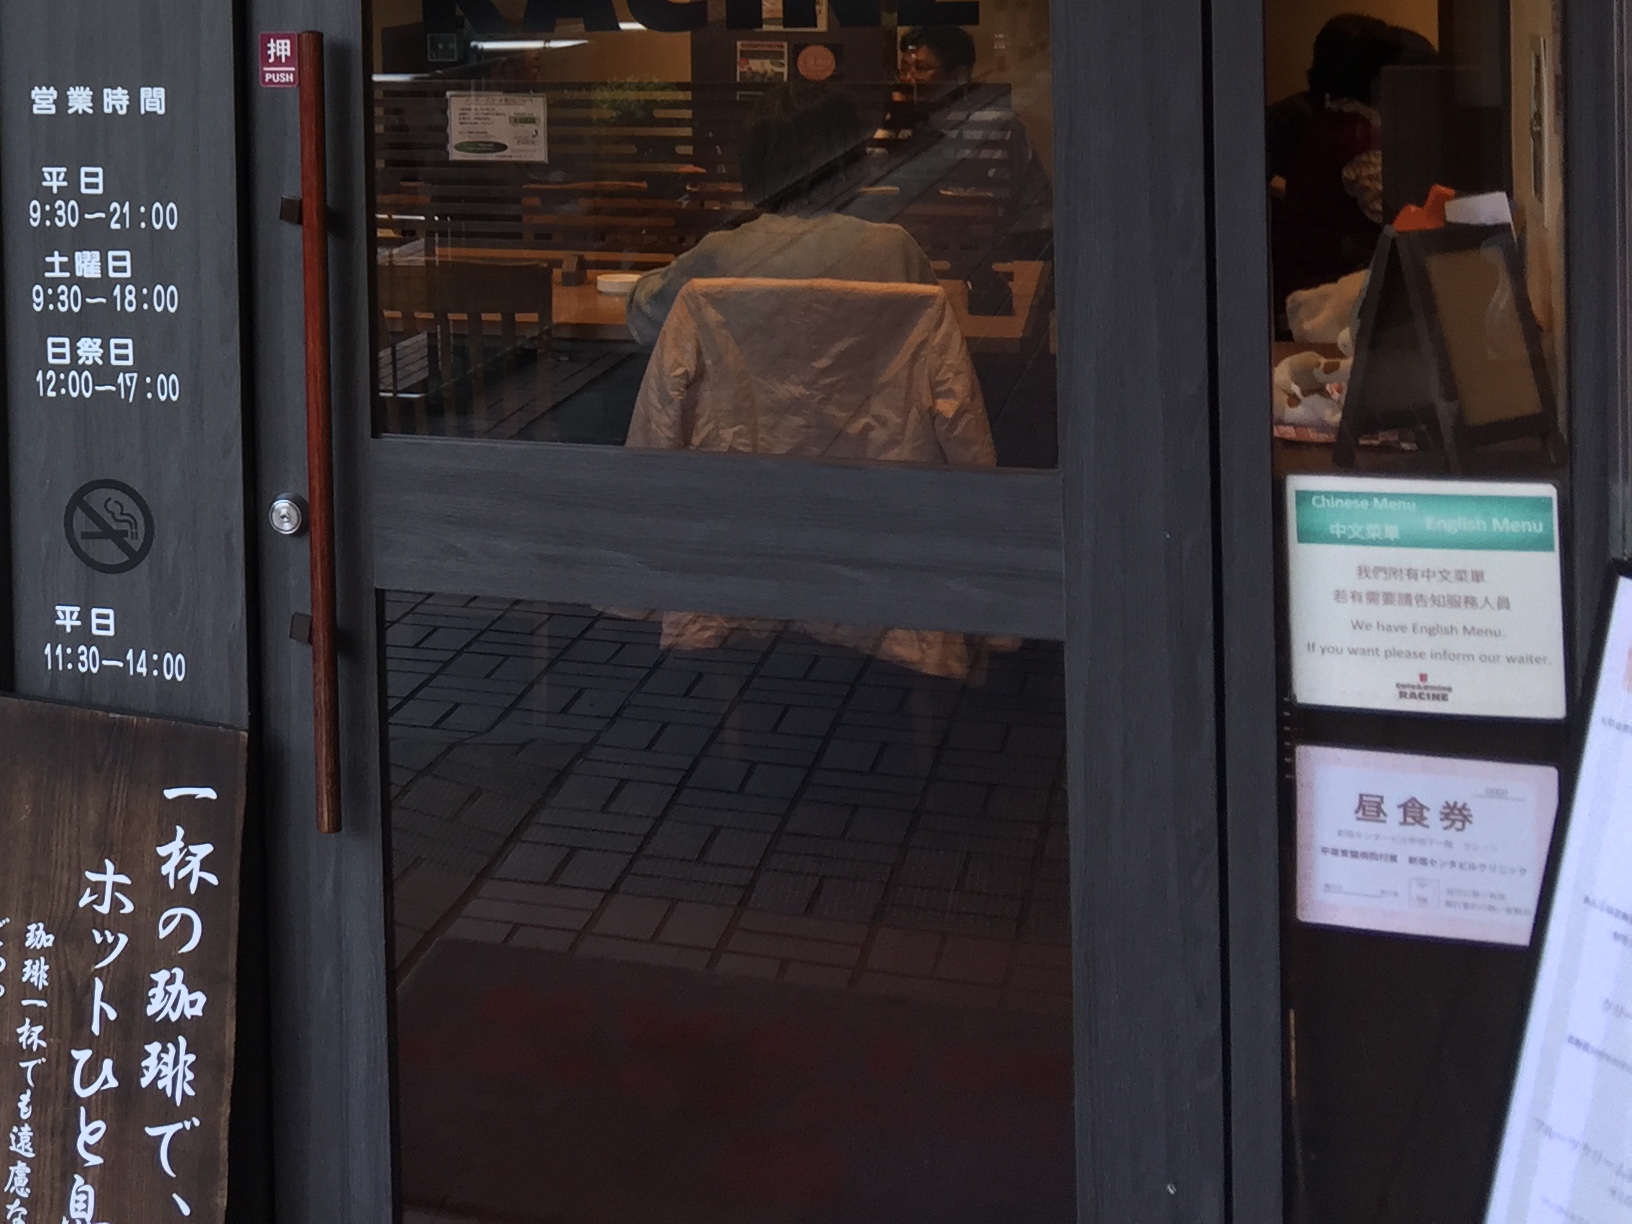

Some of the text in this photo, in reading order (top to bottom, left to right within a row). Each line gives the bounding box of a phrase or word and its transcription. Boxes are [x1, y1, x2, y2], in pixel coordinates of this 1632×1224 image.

[266, 37, 291, 64] 押
[264, 72, 294, 83] PUSH
[31, 86, 166, 115] 営業時間
[41, 166, 104, 195] 平日
[44, 250, 132, 278] 土曜日
[46, 336, 134, 366] 日祭日
[1311, 494, 1417, 512] Chinese Menu
[1425, 515, 1544, 535] English Menu
[54, 604, 115, 637] 平日
[1351, 620, 1507, 638] We have English Menu.
[1306, 641, 1553, 666] If you want please inform our waiter.
[1398, 690, 1450, 702] RACINE
[1353, 792, 1474, 833] 昼食券
